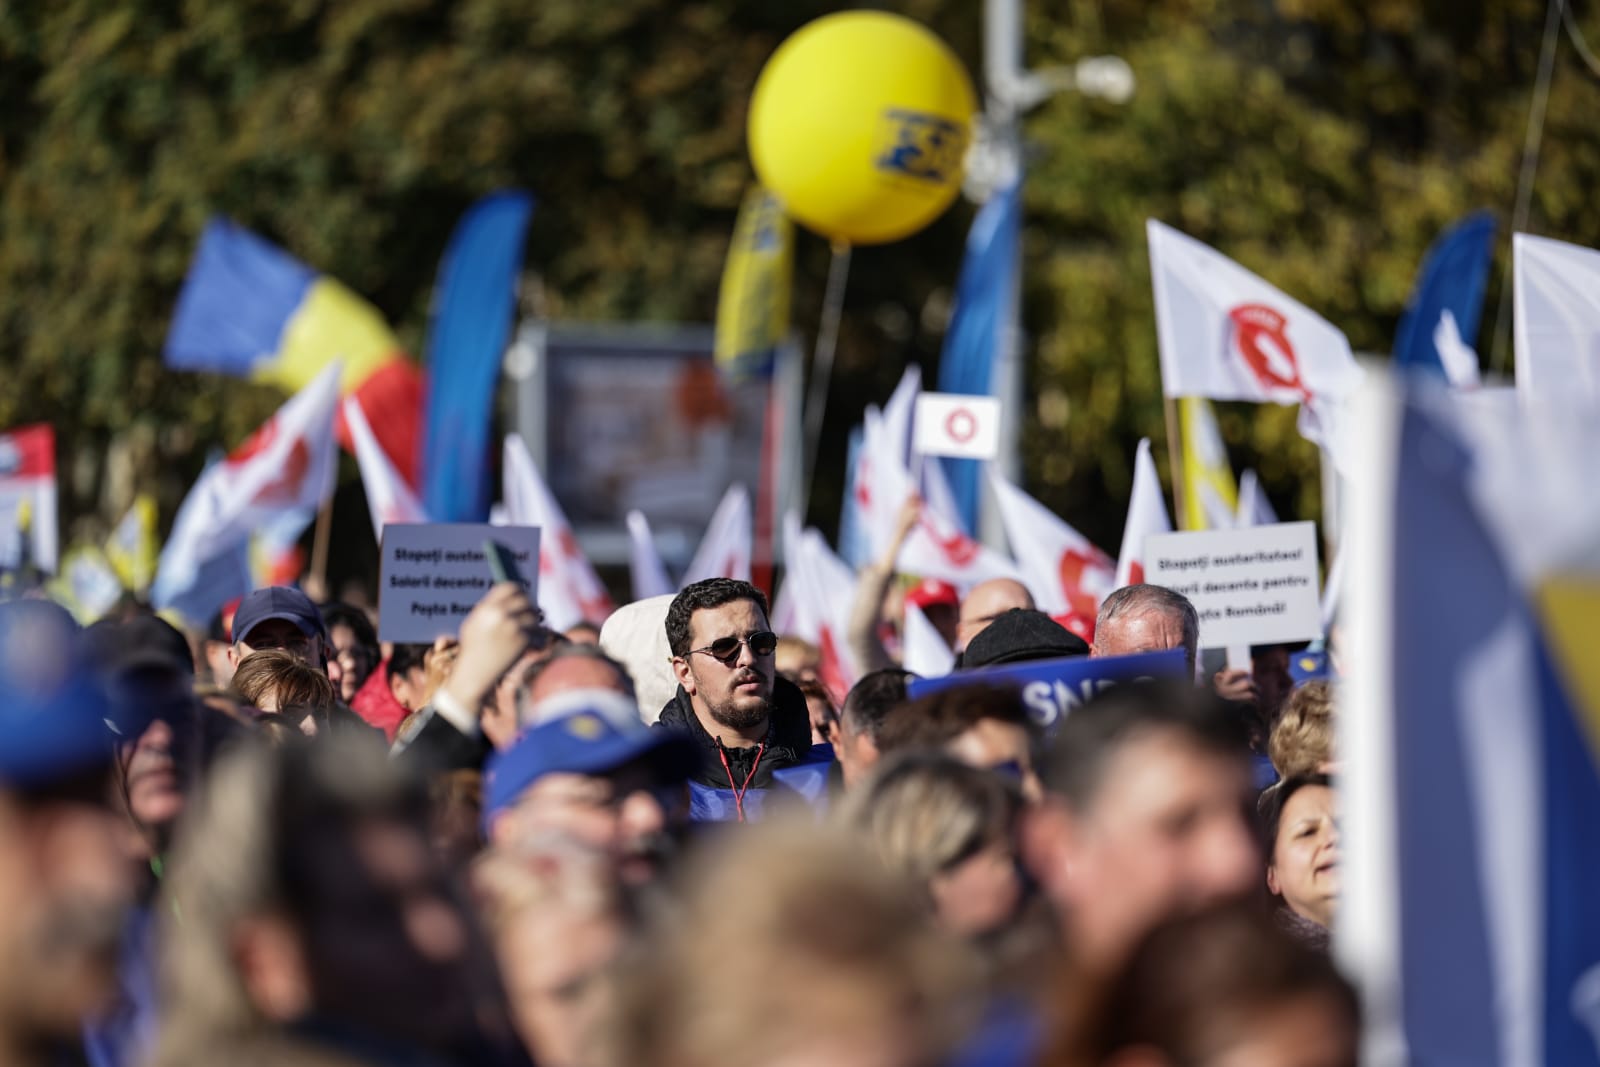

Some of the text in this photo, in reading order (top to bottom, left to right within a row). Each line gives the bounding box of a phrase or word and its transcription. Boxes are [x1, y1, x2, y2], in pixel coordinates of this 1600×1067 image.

[390, 574, 430, 589] Salarii
[434, 574, 485, 589] decente
[1204, 577, 1259, 593] decente
[1263, 573, 1309, 592] pentru
